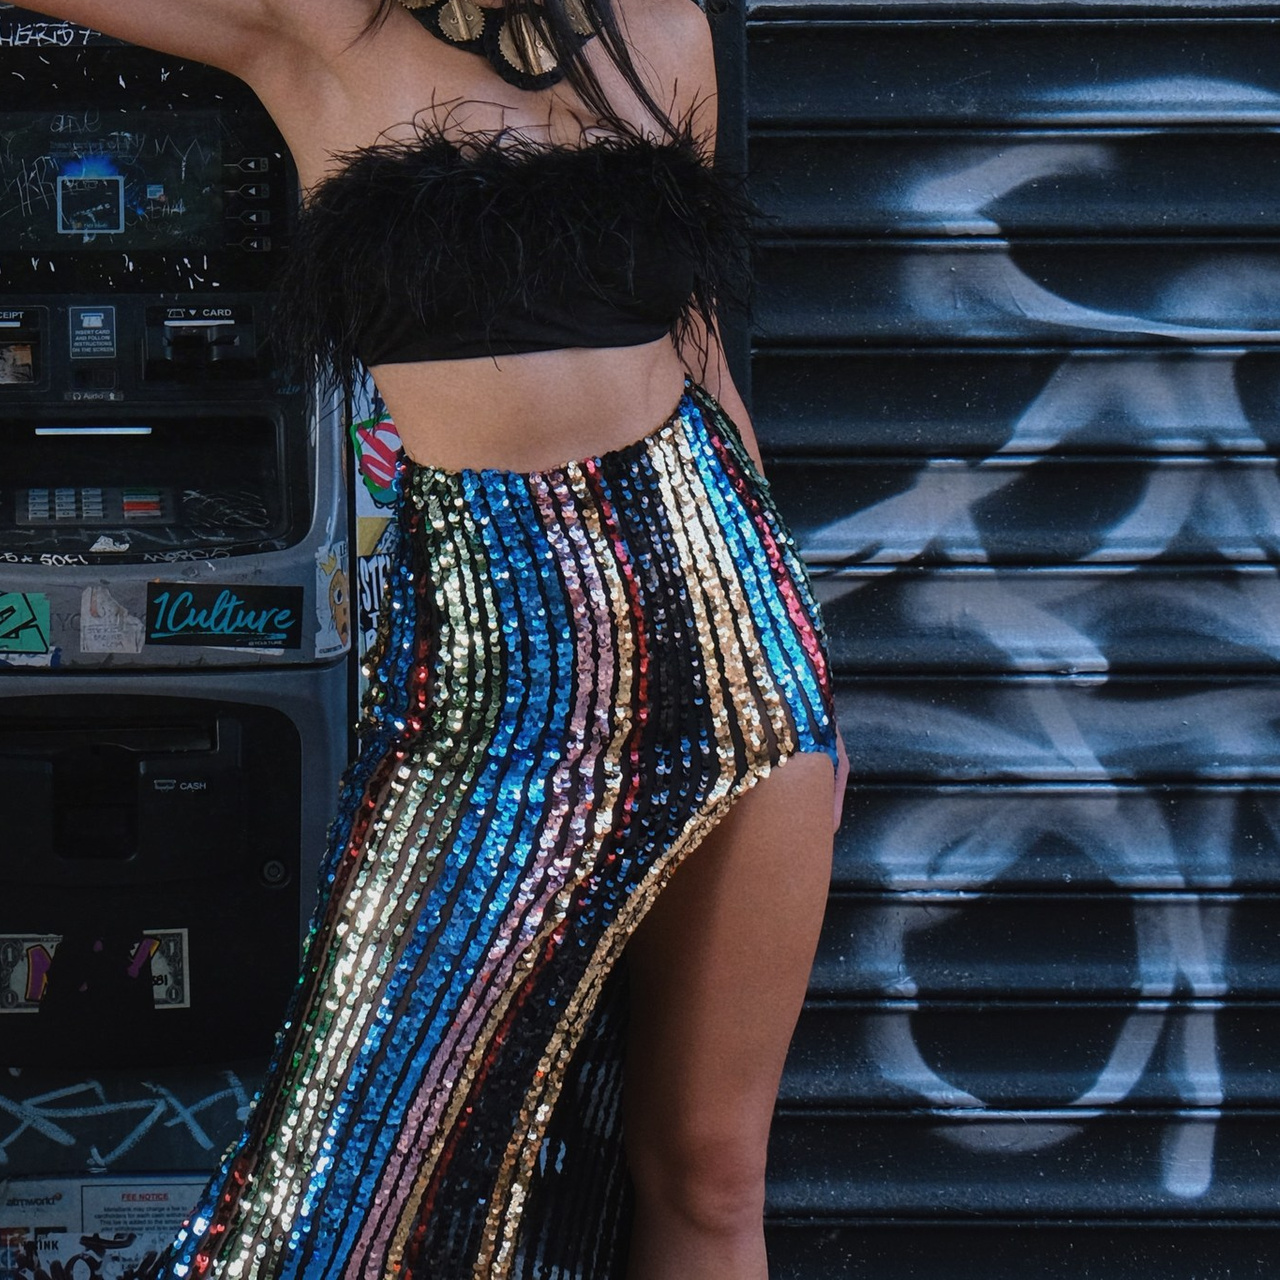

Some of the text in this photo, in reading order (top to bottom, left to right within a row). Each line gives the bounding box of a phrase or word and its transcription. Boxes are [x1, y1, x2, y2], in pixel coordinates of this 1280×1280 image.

[202, 308, 231, 318] CARD
[179, 782, 207, 791] CASH
[122, 1193, 169, 1201] FEE NOTICE
